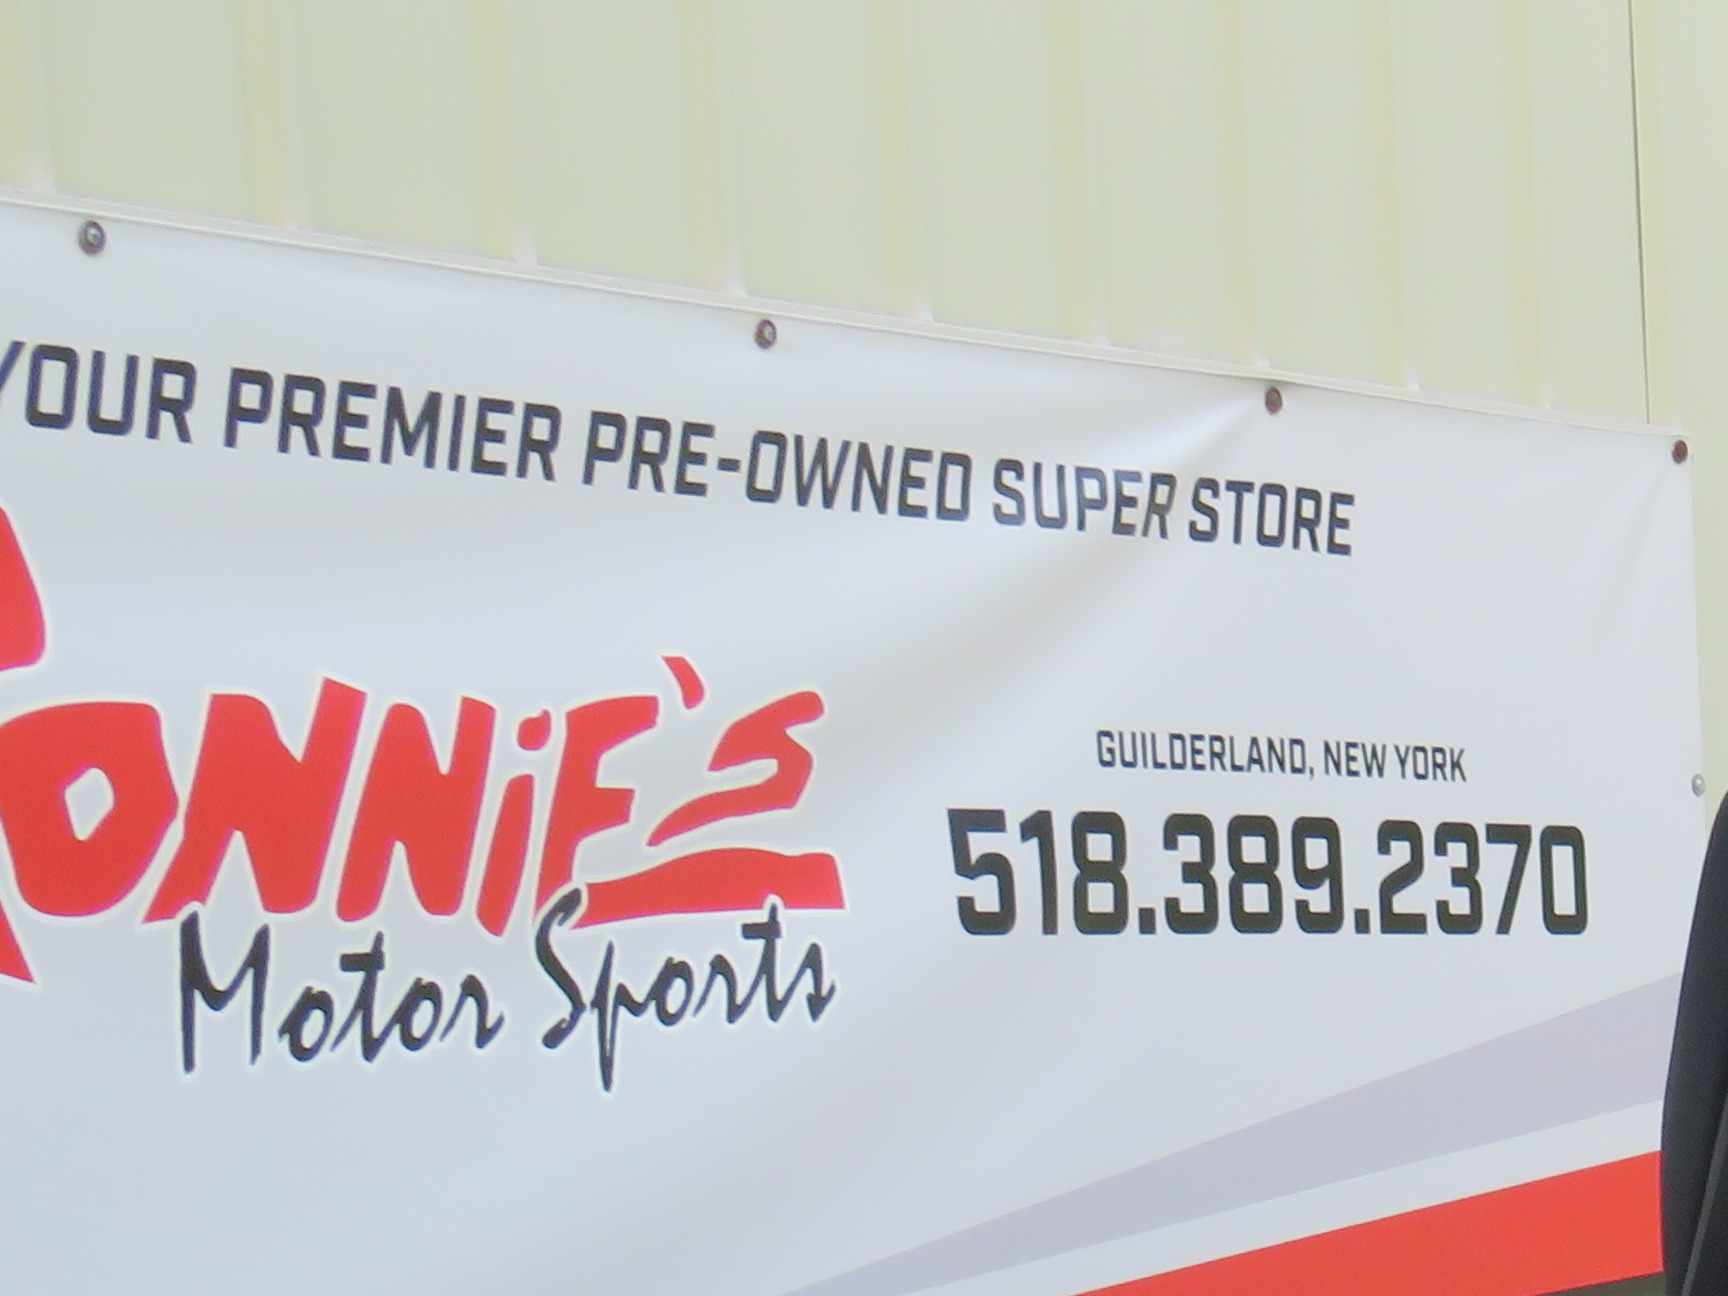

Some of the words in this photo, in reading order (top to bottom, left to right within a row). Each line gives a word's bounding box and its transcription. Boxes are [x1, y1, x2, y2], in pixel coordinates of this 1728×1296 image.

[224, 367, 561, 482] PREMIER
[583, 410, 972, 521] PRE-OWNED
[993, 458, 1178, 540] SUPER
[1188, 477, 1355, 557] STORE
[1096, 730, 1317, 782] GUILDERLAND,
[1323, 740, 1387, 778] NEW
[1394, 745, 1468, 783] YORK
[948, 808, 1588, 936] 518.389.2370
[180, 912, 505, 1074] Motor
[535, 887, 838, 1092] Sports
